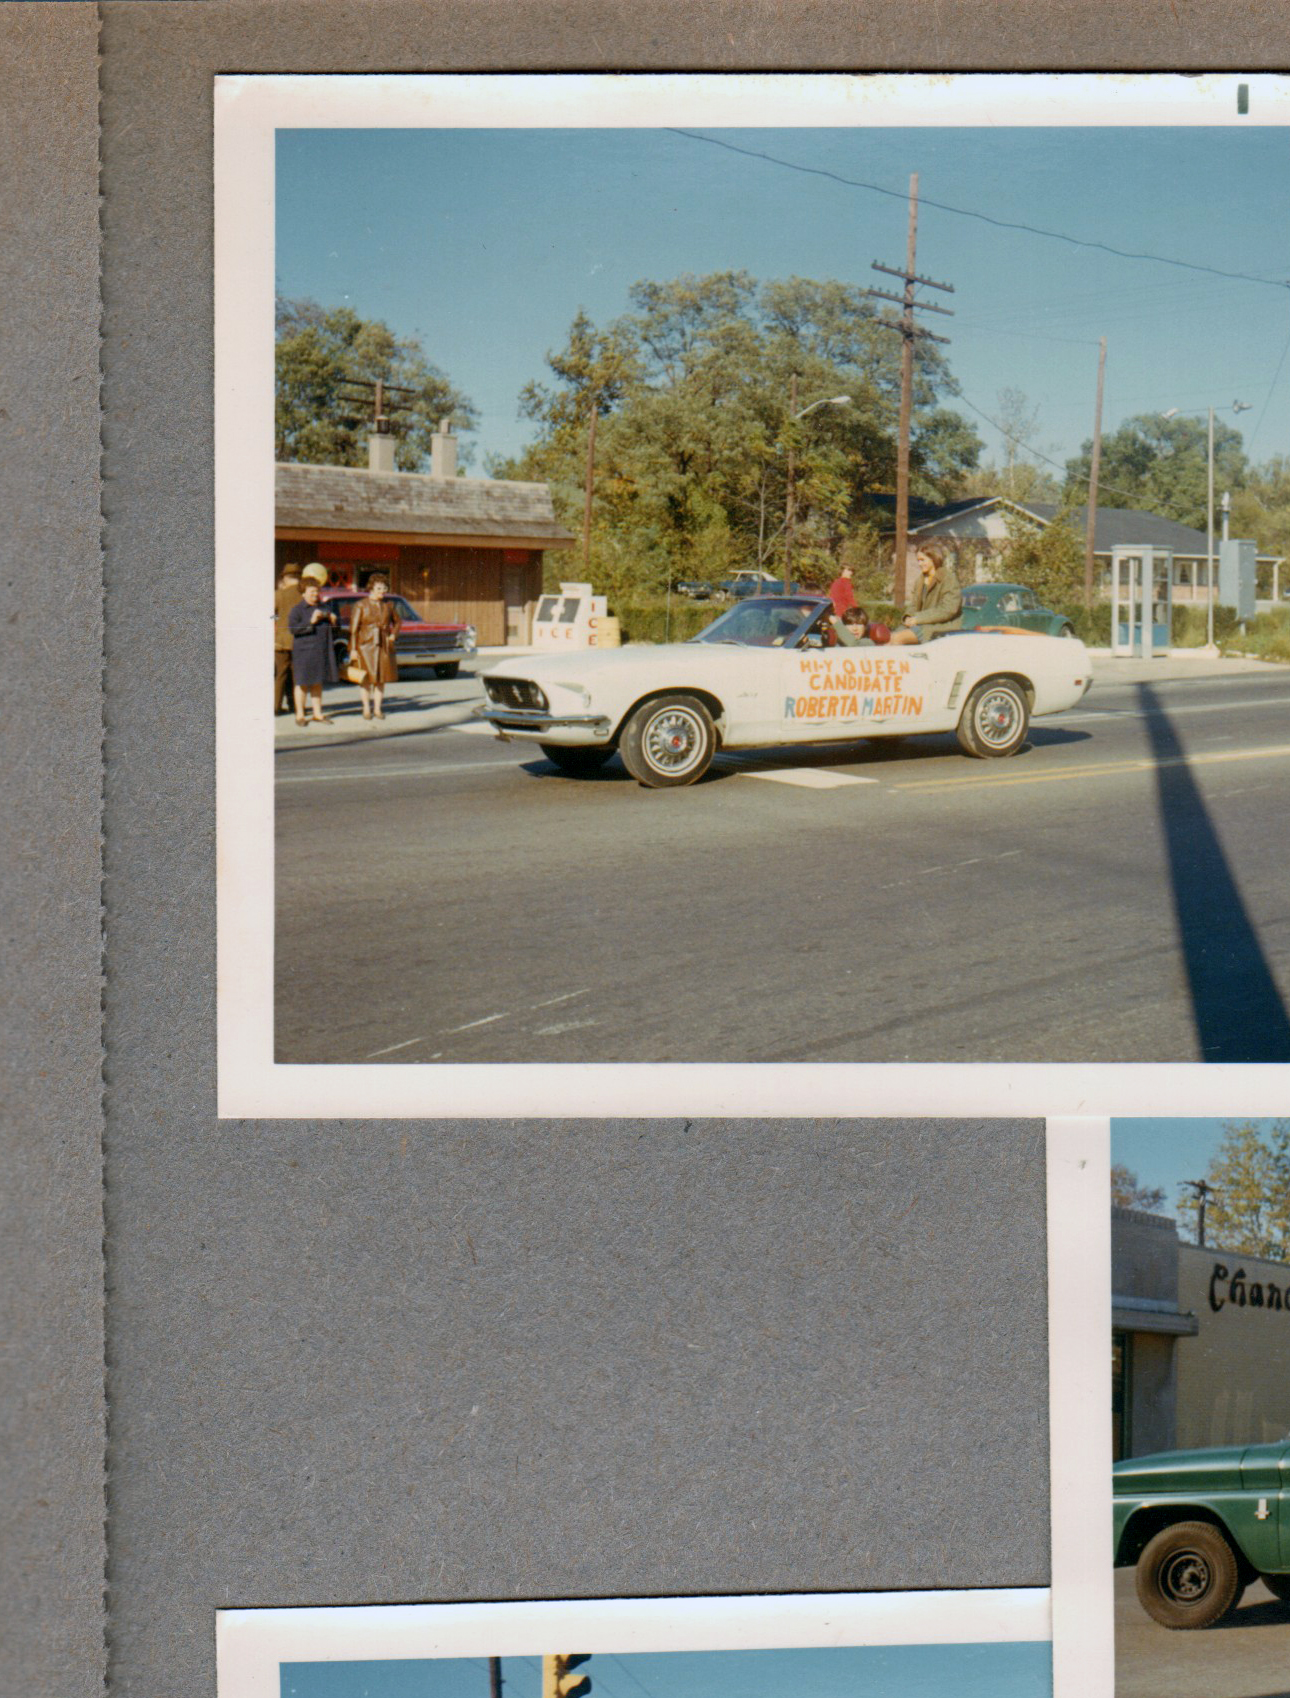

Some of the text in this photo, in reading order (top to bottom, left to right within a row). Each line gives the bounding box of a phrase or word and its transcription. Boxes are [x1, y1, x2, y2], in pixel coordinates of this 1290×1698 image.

[539, 628, 573, 639] ICE
[588, 602, 599, 646] ICE
[800, 659, 911, 675] HI-Y QUEEN
[784, 695, 924, 718] ROBERTA MARTIN
